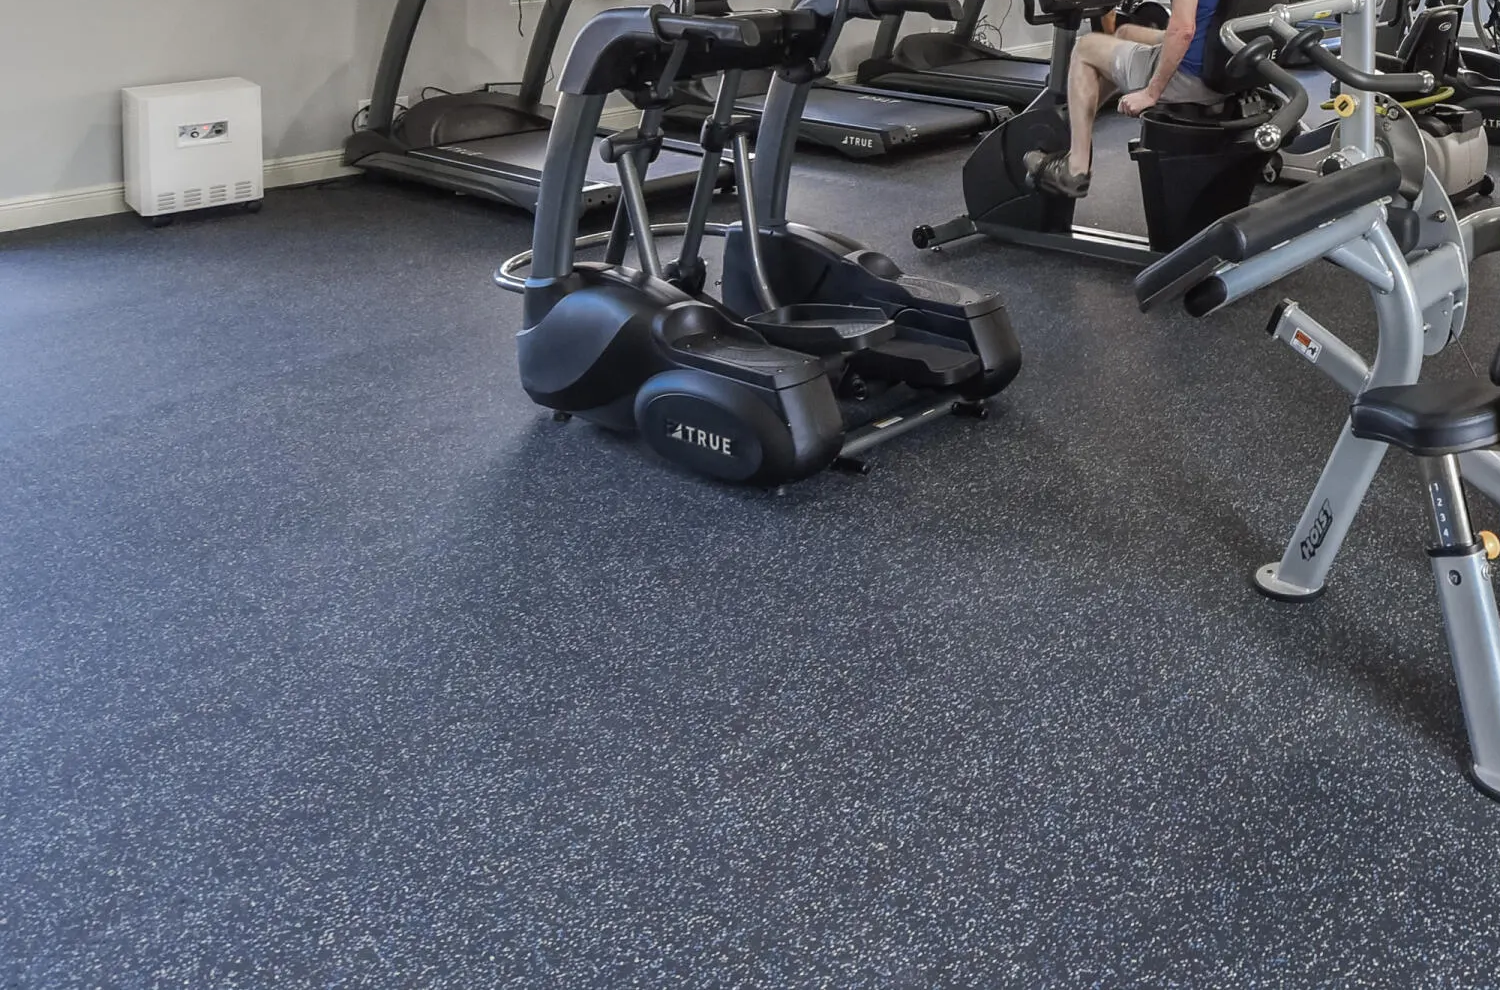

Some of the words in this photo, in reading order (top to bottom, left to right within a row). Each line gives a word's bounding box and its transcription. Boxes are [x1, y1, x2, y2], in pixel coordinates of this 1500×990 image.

[849, 136, 873, 148] TRUE
[685, 425, 732, 455] TRUE
[1433, 482, 1439, 491] 1
[1436, 497, 1443, 507] 2
[1440, 512, 1446, 522] 3
[1300, 497, 1333, 561] HOIST
[1443, 527, 1449, 537] 4
